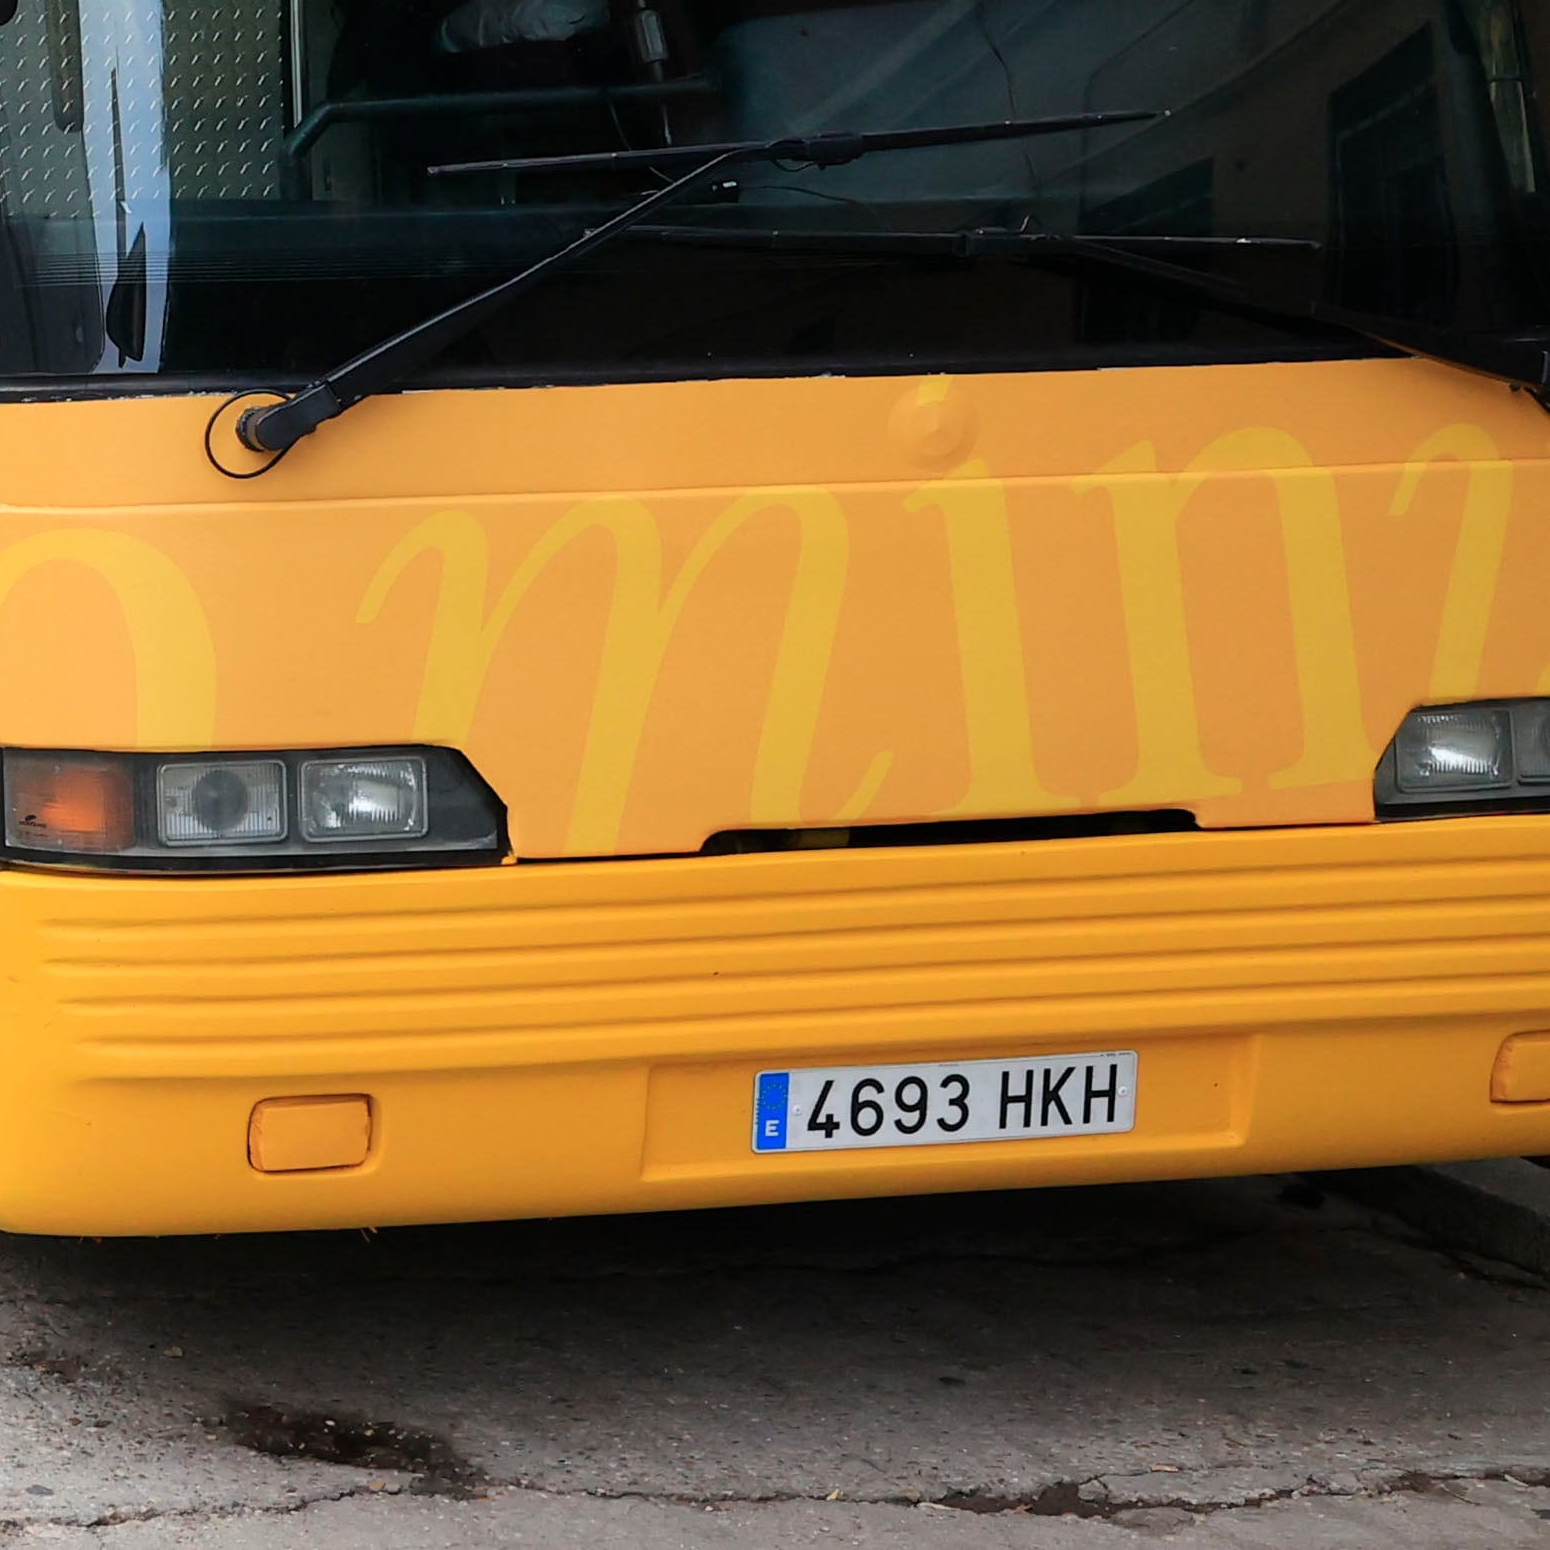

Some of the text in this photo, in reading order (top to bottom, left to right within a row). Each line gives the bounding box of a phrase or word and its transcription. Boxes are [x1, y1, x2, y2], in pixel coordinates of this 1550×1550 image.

[764, 1063, 1119, 1139] E 4693 HKH
